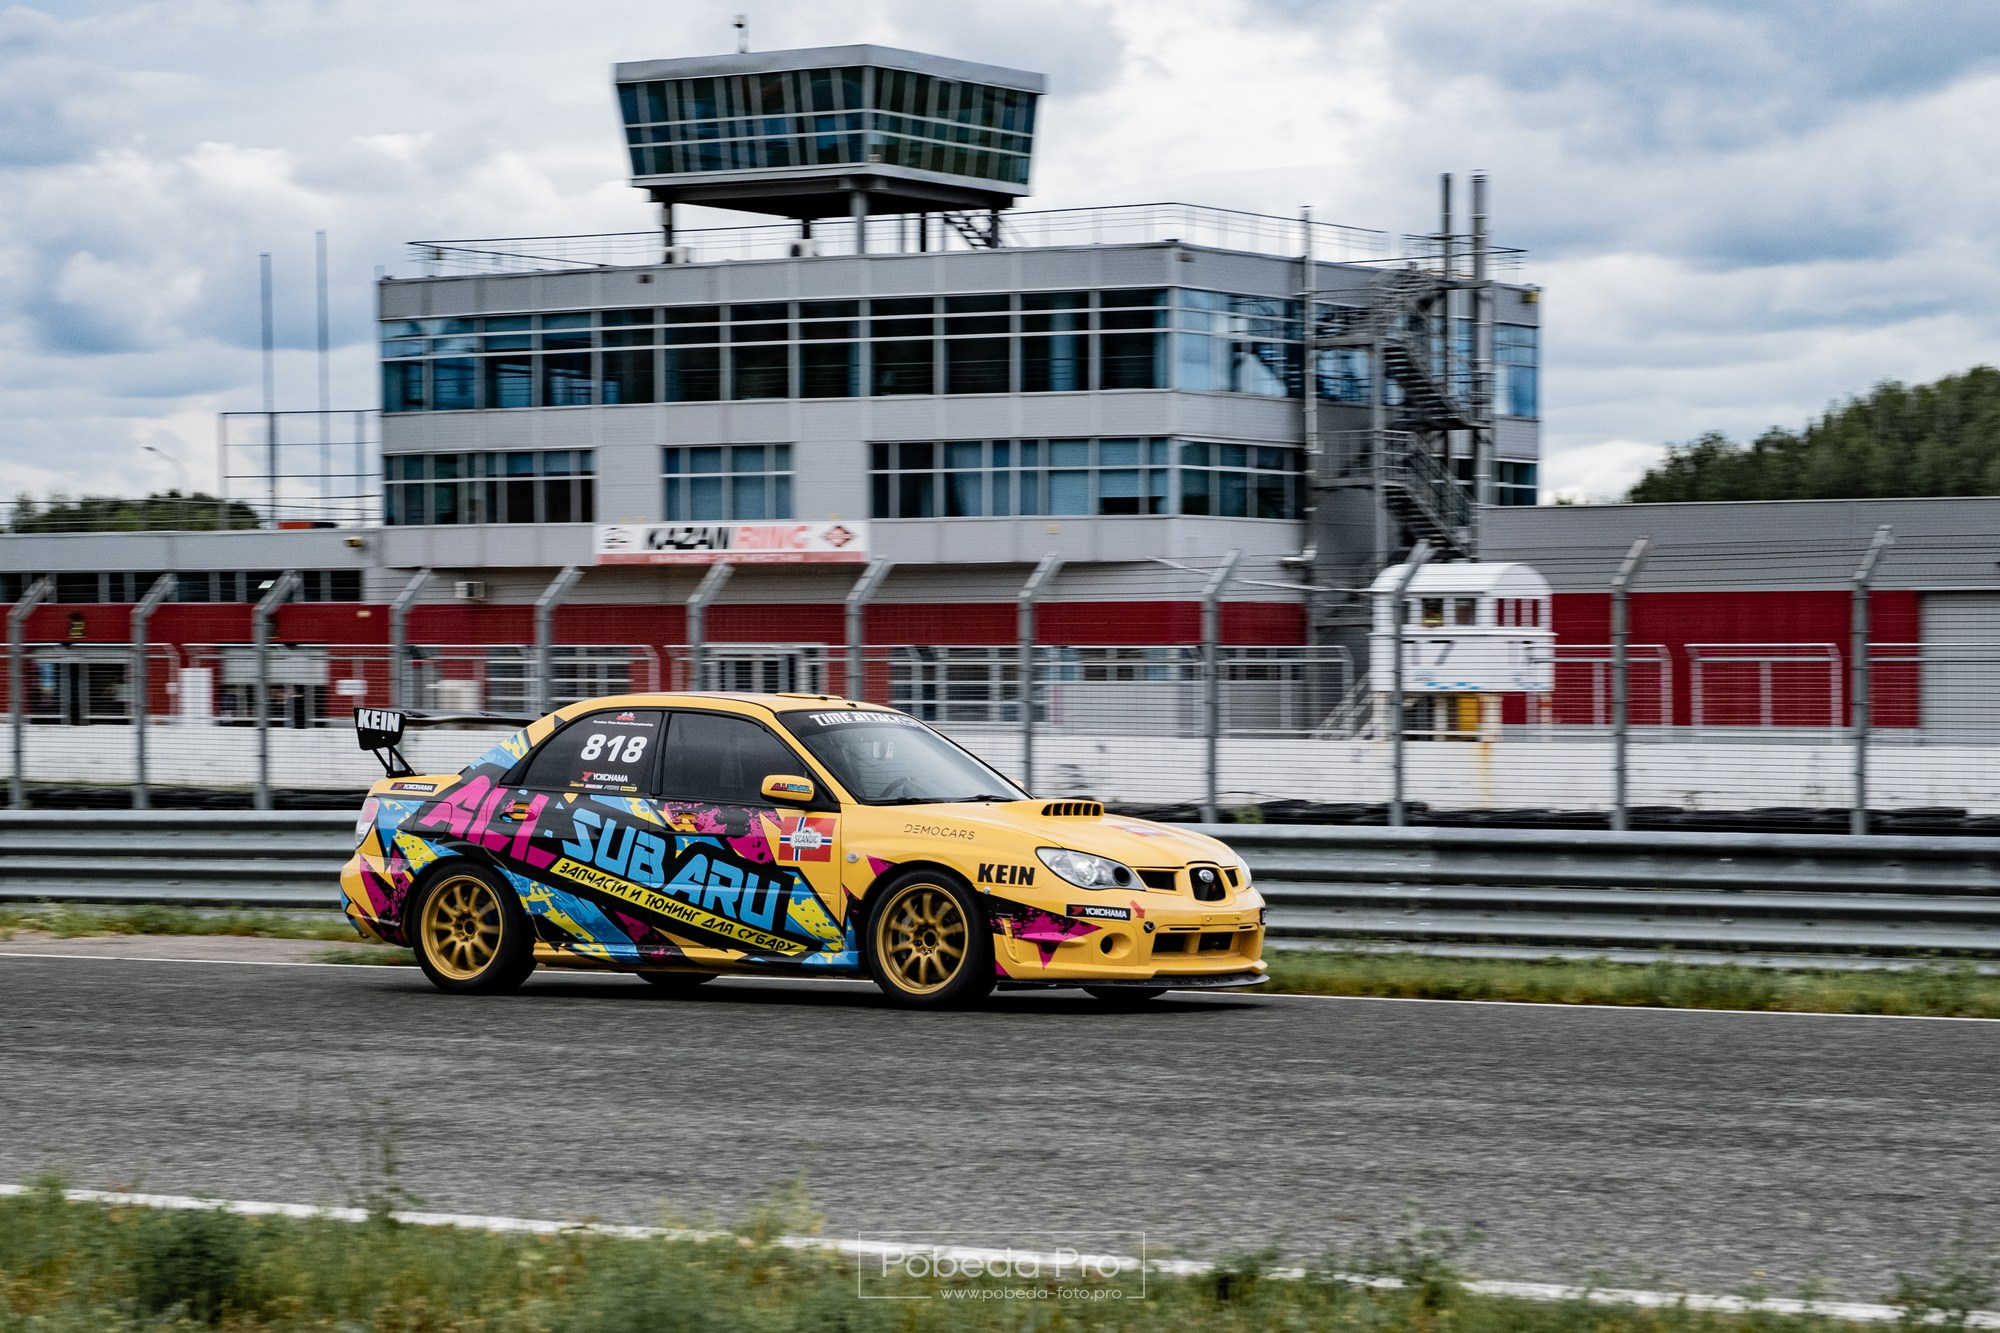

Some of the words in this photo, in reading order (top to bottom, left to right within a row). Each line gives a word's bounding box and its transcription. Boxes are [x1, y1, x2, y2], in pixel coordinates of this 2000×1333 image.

[647, 526, 728, 549] KAZAN
[357, 708, 400, 733] KEIN
[809, 712, 851, 726] TIME
[580, 734, 648, 763] 818
[593, 773, 628, 782] YOKOHAMA
[794, 833, 819, 844] SCANDIC
[904, 824, 975, 840] DEMOCARS
[419, 775, 557, 869] ALL
[562, 807, 782, 930] SUBARU
[977, 863, 1036, 886] KEIN
[558, 864, 630, 897] ЗАПЧАСТИ
[631, 888, 643, 903] И
[646, 894, 702, 923] ТЮНИНГ
[701, 917, 735, 936] ДЛЯ
[737, 929, 800, 951] СУБАРУ
[1084, 907, 1129, 919] YOKOHAMA
